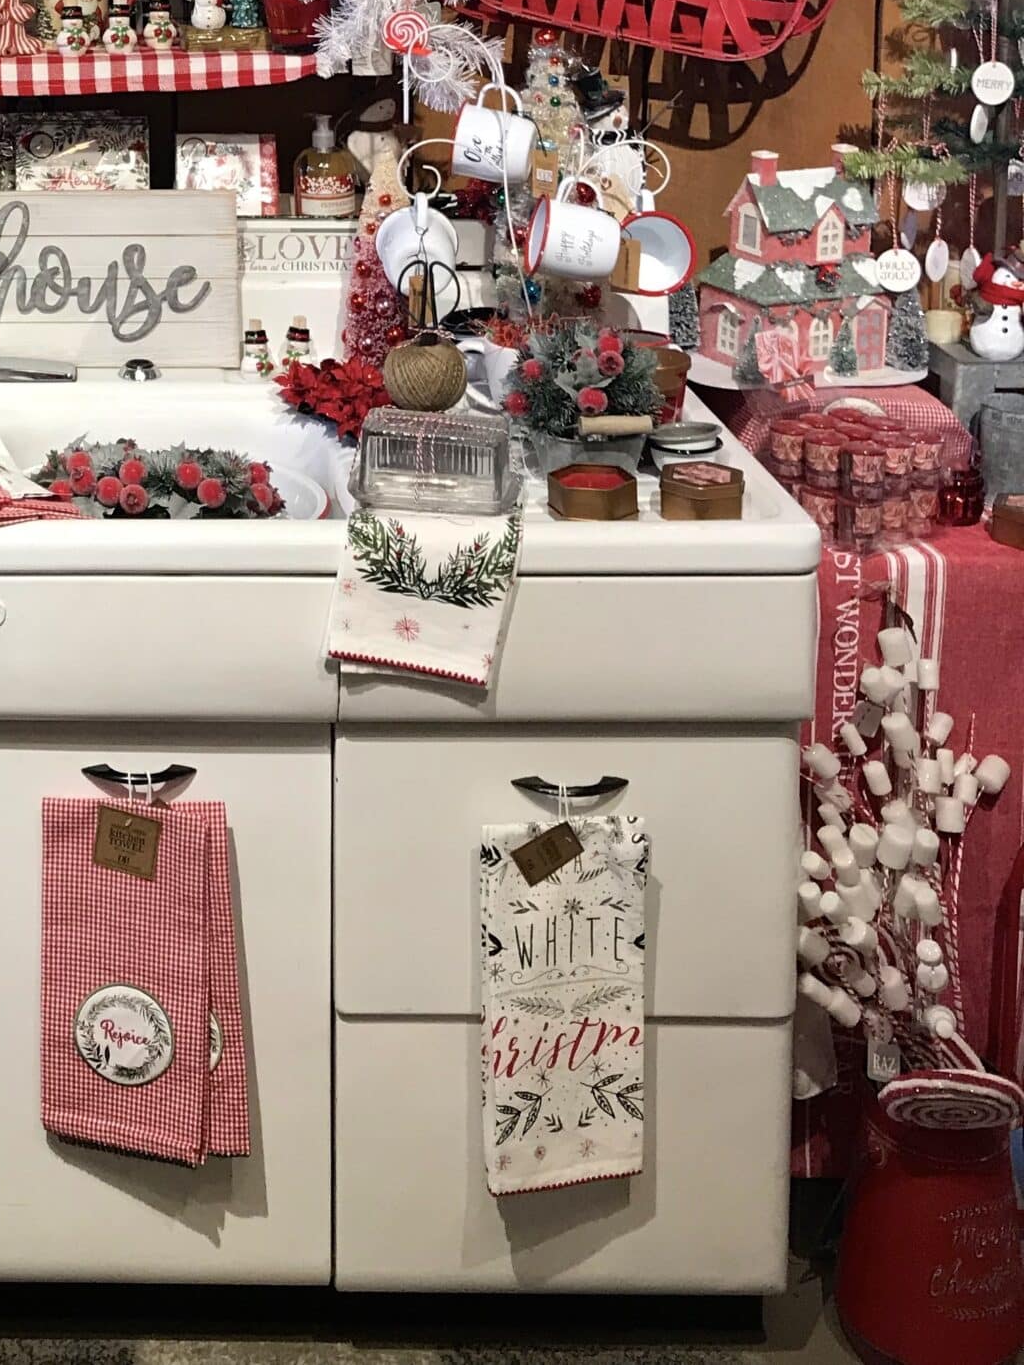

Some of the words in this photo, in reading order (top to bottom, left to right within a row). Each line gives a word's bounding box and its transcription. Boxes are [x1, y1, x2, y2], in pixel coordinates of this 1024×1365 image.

[257, 235, 353, 261] LOVE
[832, 598, 861, 740] WONDER
[514, 914, 625, 970] WHITE
[100, 1020, 153, 1045] Rejoice
[873, 1053, 896, 1073] RAZ
